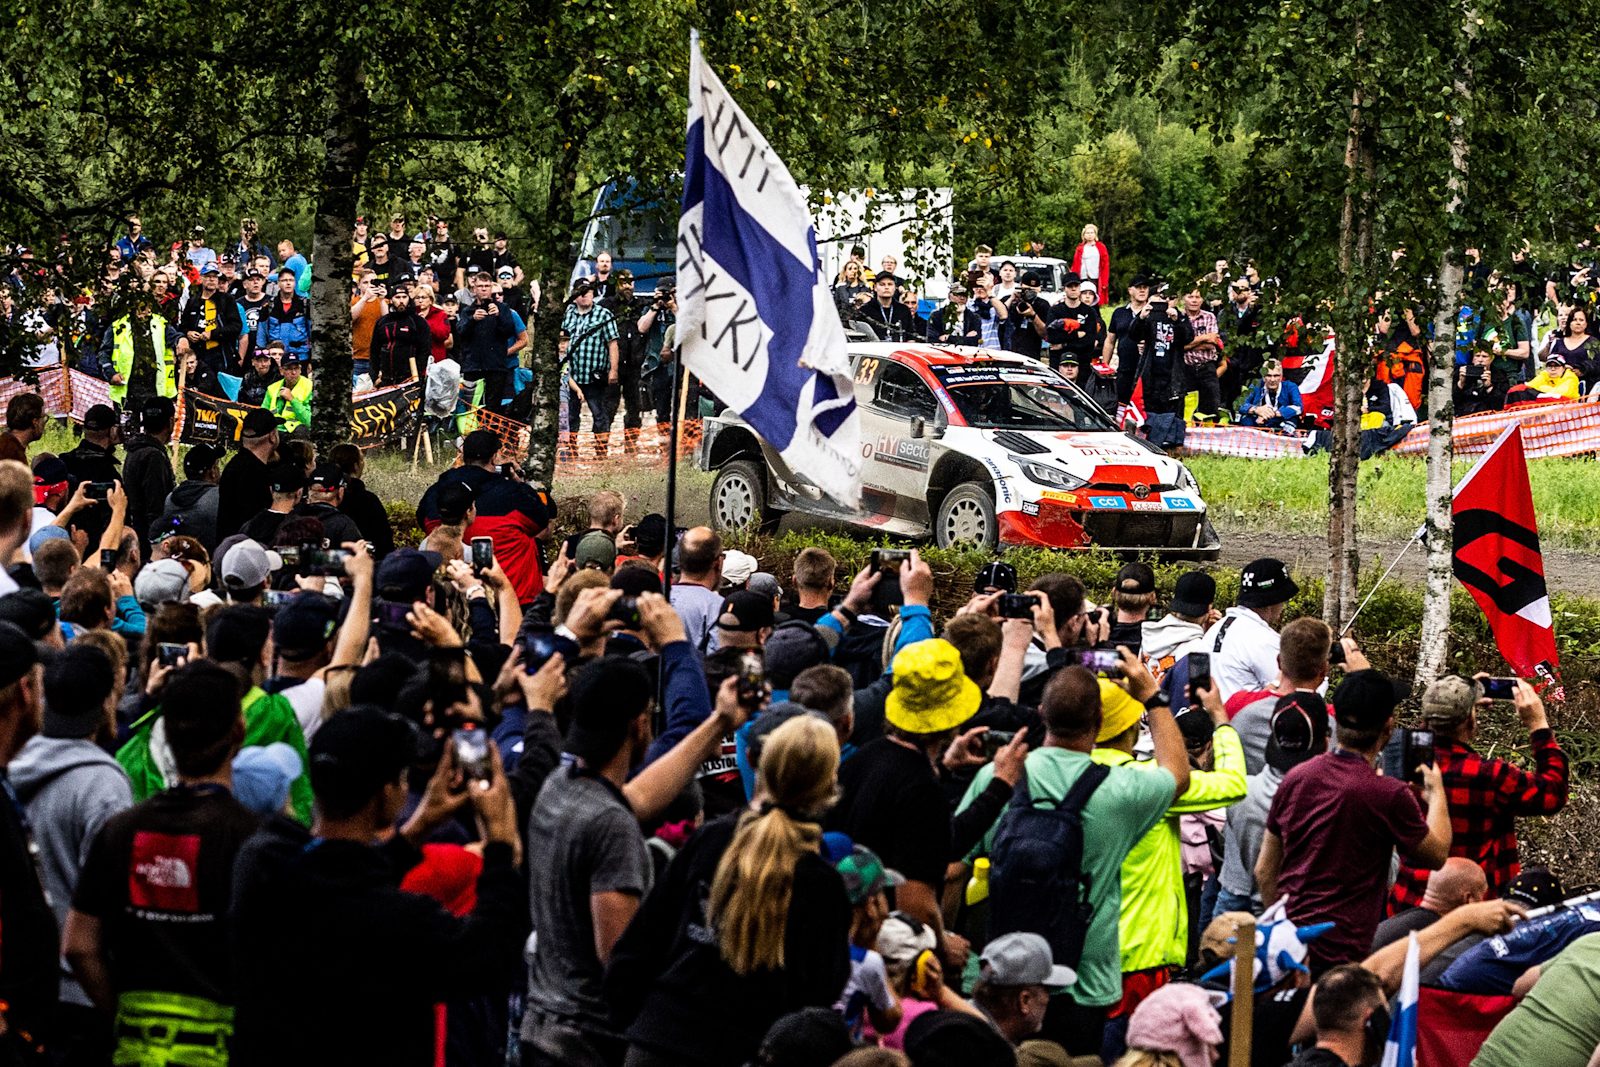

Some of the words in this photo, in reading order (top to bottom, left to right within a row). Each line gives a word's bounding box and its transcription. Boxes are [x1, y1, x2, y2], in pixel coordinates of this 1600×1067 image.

[855, 358, 880, 385] 33
[1080, 447, 1141, 457] DENSO
[1098, 497, 1119, 507] CCI
